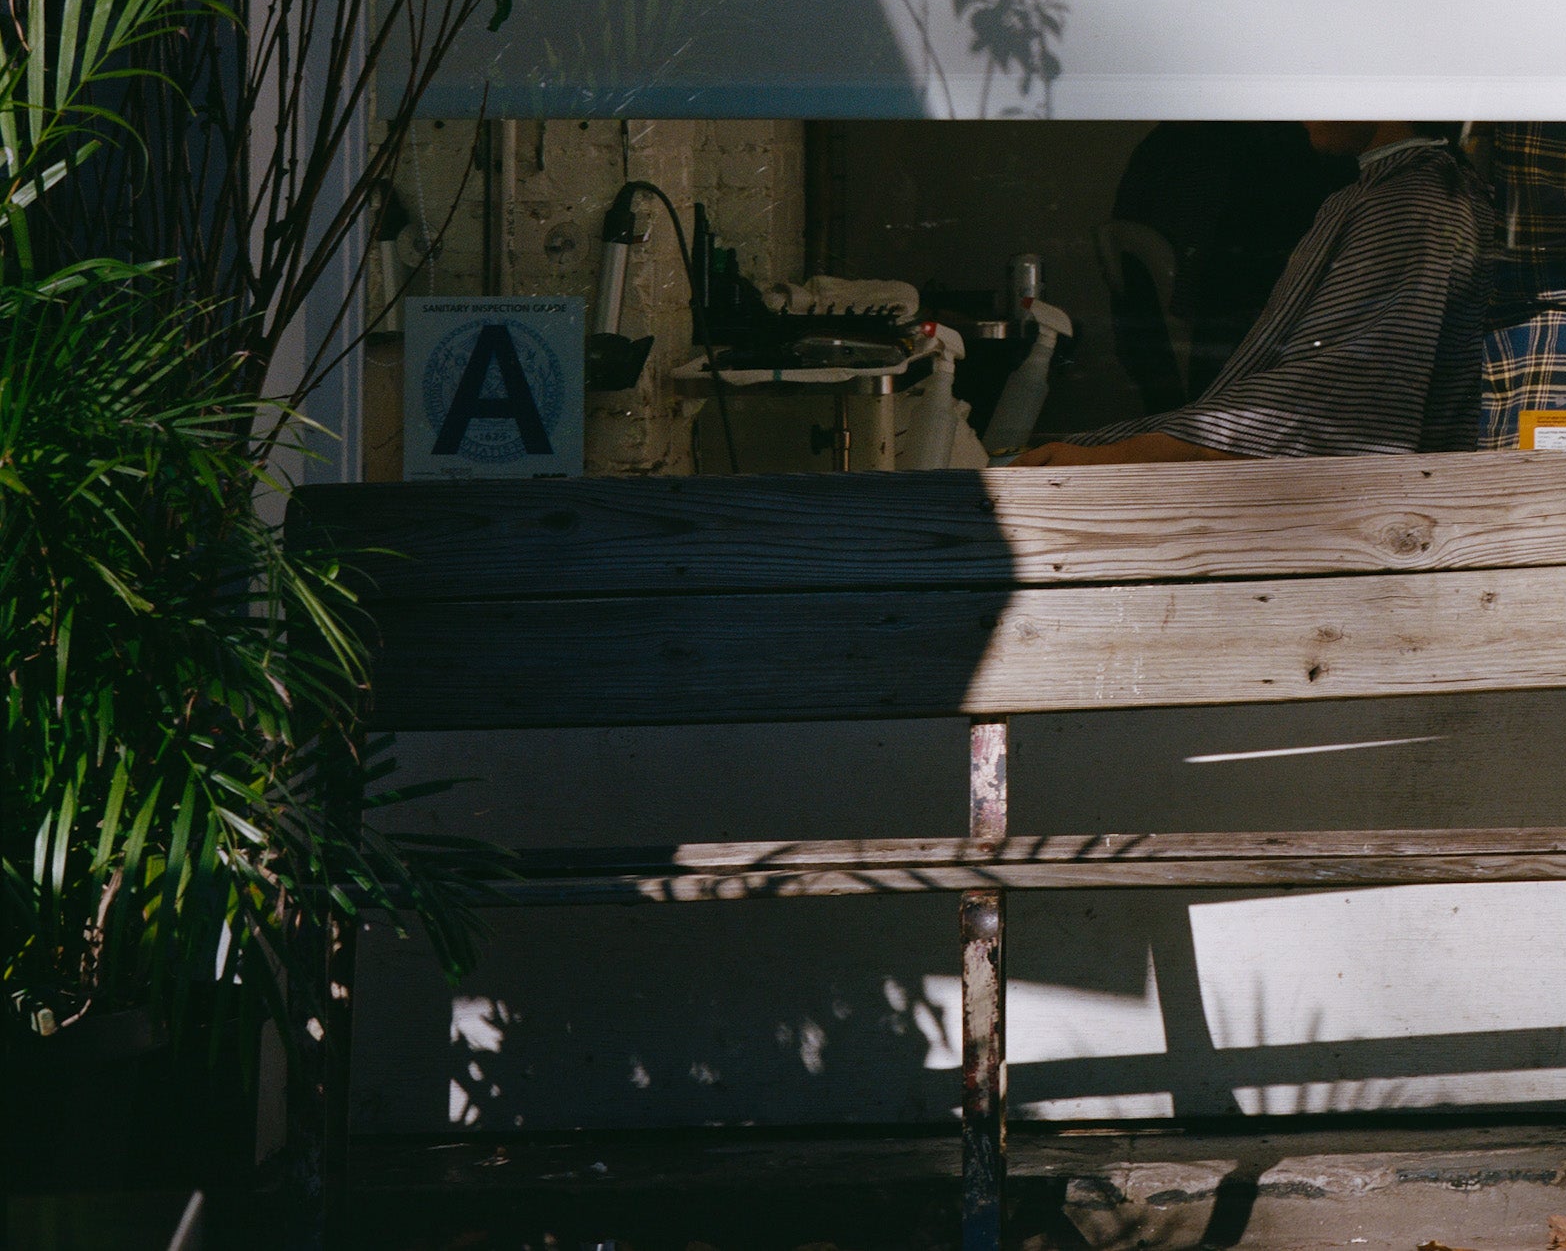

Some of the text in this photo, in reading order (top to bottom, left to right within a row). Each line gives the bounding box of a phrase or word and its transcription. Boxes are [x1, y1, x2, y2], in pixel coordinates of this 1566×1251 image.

[422, 304, 567, 313] SANITARY INSPECTION GRADE
[431, 325, 554, 455] A
